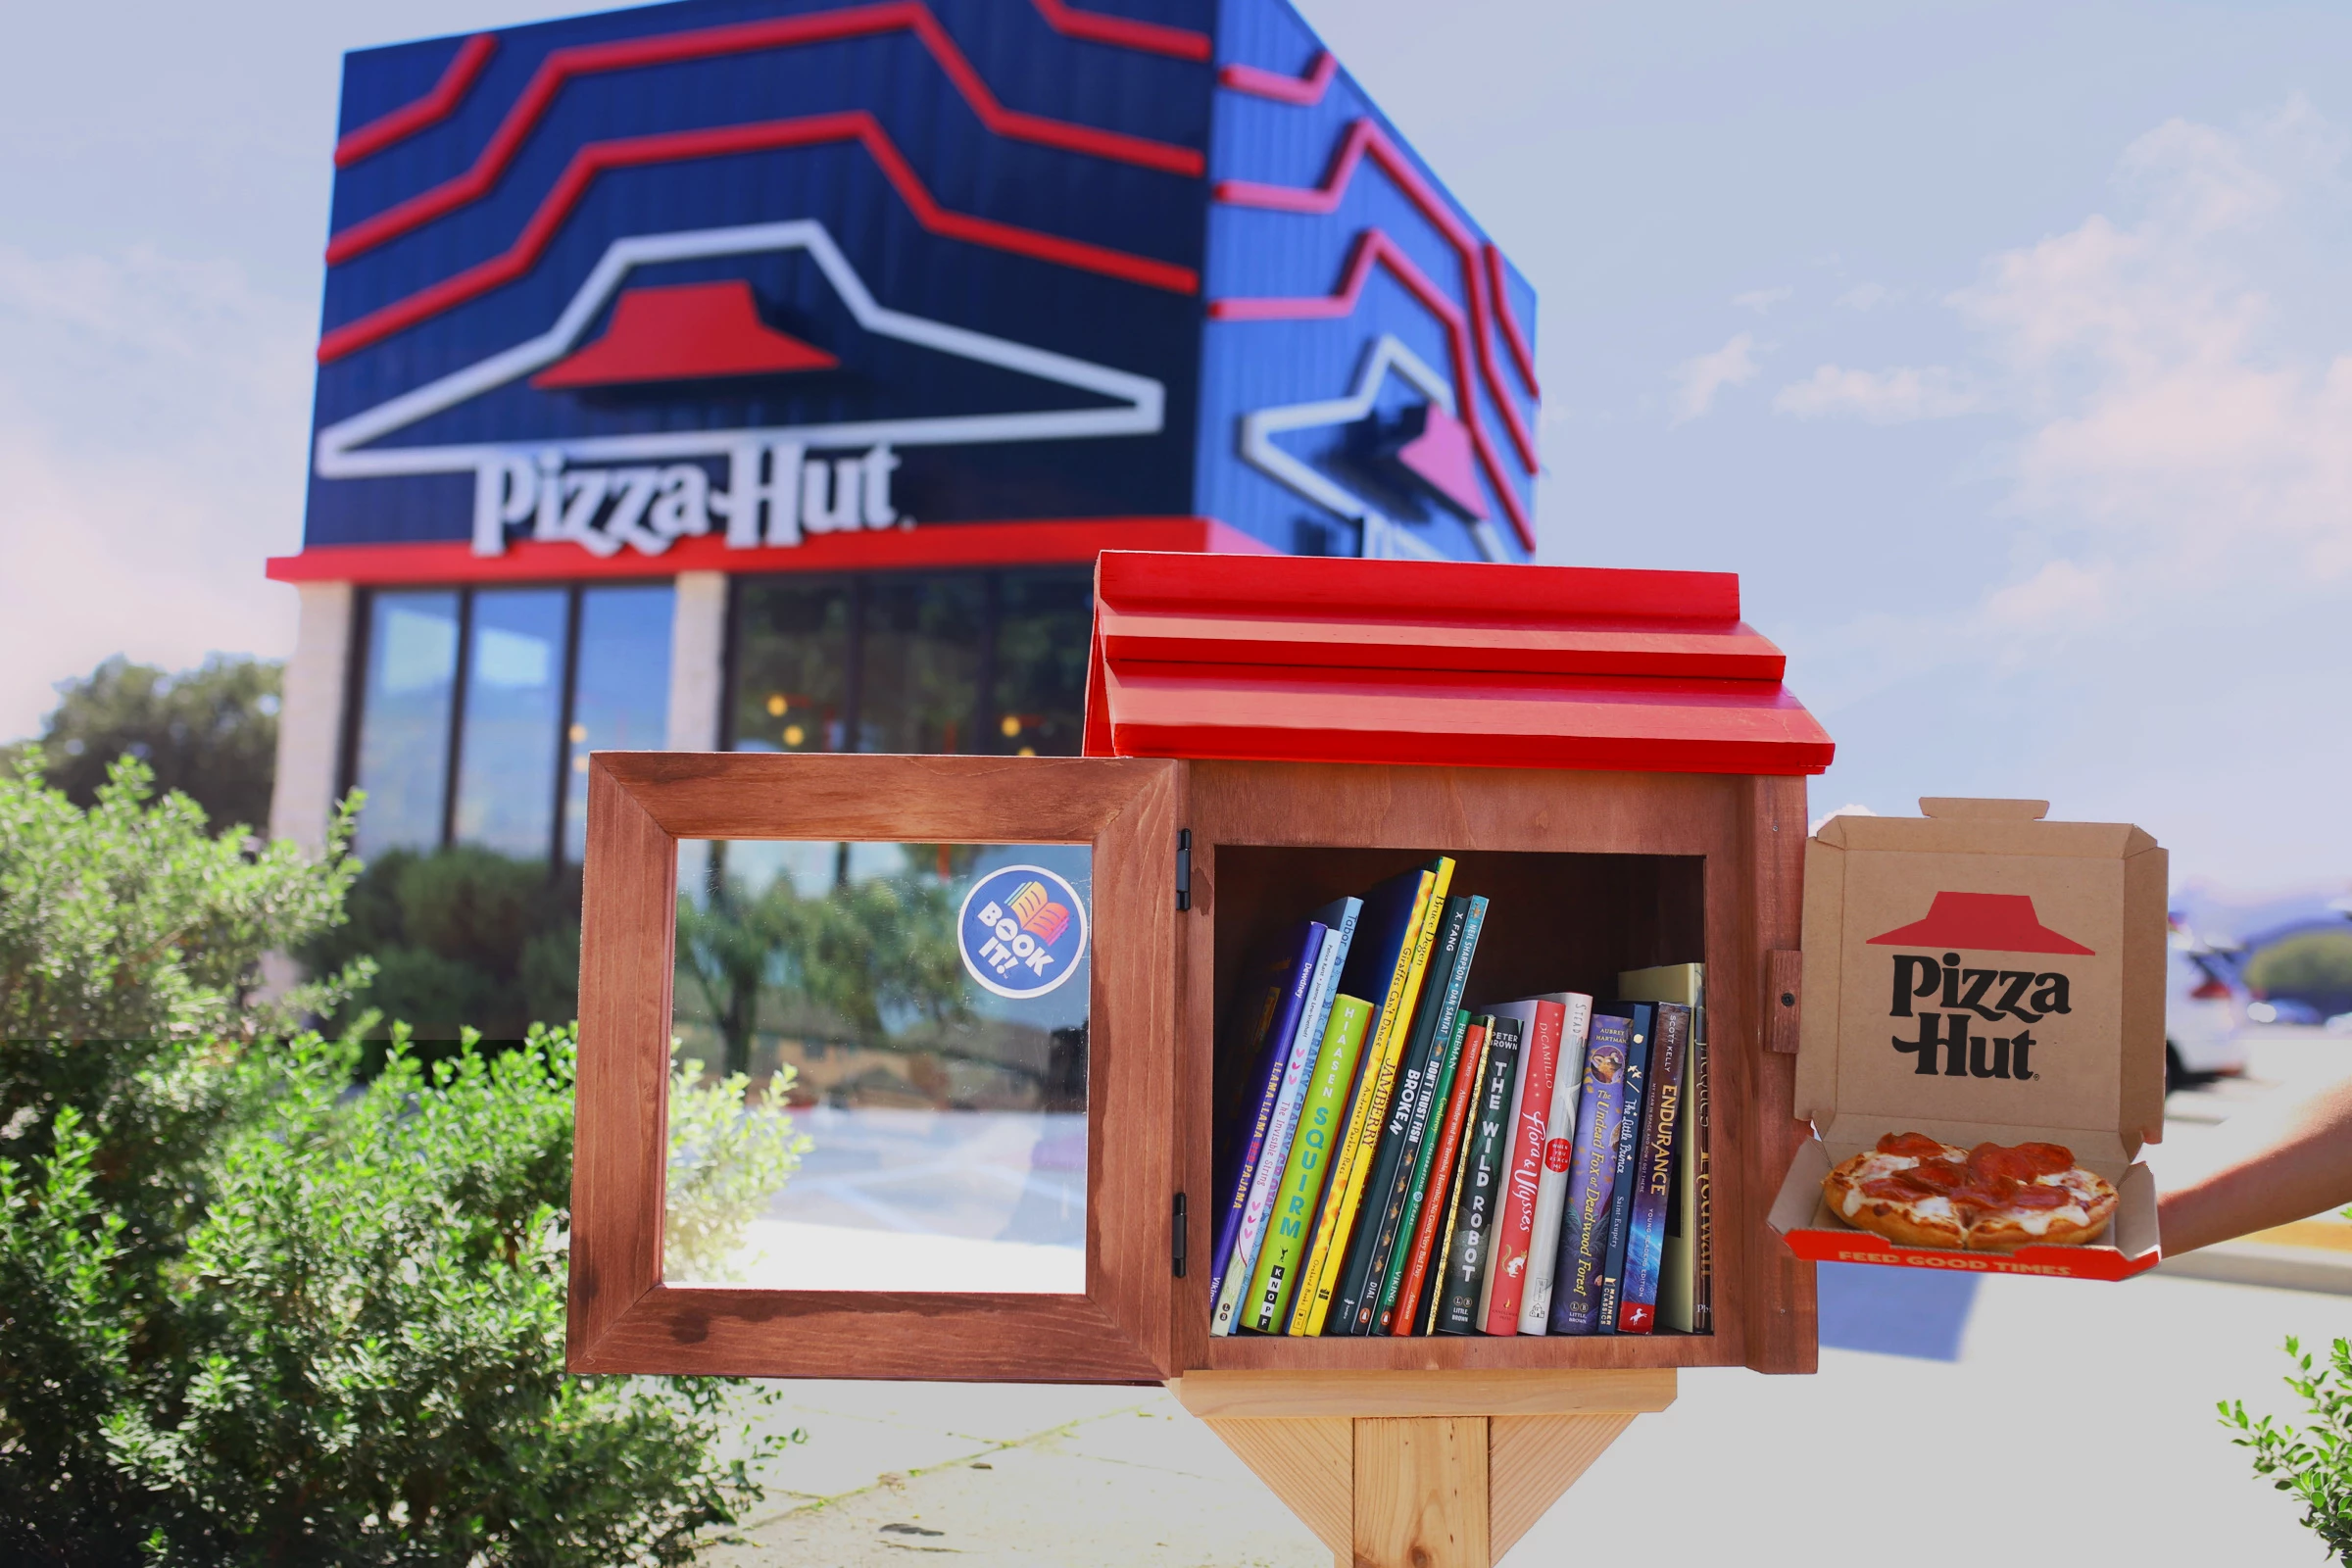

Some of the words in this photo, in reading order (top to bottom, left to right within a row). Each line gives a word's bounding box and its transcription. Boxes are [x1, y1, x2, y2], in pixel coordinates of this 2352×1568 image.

[471, 447, 710, 557] Pizza
[708, 441, 900, 549] Hut
[1428, 895, 1446, 927] Bruce
[1454, 911, 1464, 921] X.
[977, 901, 1054, 977] BOOK
[1340, 914, 1358, 947] Tabor
[1446, 924, 1460, 952] FANG
[1468, 923, 1478, 940] NEIL
[978, 936, 1019, 975] IT!
[1416, 931, 1435, 966] Degen
[1454, 940, 1473, 982] SHARPSON
[1295, 962, 1312, 999] Dewdney
[1394, 947, 1412, 986] Giraffes
[1386, 991, 1399, 1014] Can't
[1450, 989, 1459, 1004] DAN
[1888, 953, 2072, 1023] Pizza
[1375, 1018, 1392, 1047] Dance
[1441, 1005, 1454, 1035] SANTAT
[1572, 1003, 1587, 1034] STEAD
[1668, 1015, 1677, 1044] SCOTT
[1322, 1006, 1354, 1099] HIAASEN
[1448, 1023, 1466, 1070] FREEMAN
[1595, 1035, 1627, 1044] HARTMAN
[1891, 1012, 2036, 1081] Hut
[1424, 1061, 1440, 1089] DON'T
[1664, 1046, 1673, 1073] KELLY
[1266, 1061, 1283, 1099] LLAMA
[1489, 1061, 1507, 1110] THE
[1597, 1089, 1612, 1100] The
[1651, 1082, 1657, 1091] MY
[1278, 1102, 1290, 1116] The
[1361, 1057, 1396, 1149] JAMBERRY
[1389, 1069, 1421, 1136] BROKEN
[1417, 1091, 1435, 1117] TRUST
[1431, 1098, 1447, 1134] Corduroy
[1454, 1089, 1466, 1122] Alexander
[1624, 1099, 1638, 1116] The
[1253, 1101, 1272, 1138] LLAMA
[1409, 1119, 1423, 1144] FISH
[1522, 1110, 1545, 1158] Flora
[1592, 1101, 1610, 1150] Undead
[1621, 1114, 1634, 1141] Little
[1247, 1141, 1260, 1162] RED
[1267, 1119, 1285, 1156] Invisible
[1340, 1128, 1359, 1174] Parker-Rees
[1650, 1085, 1678, 1196] ENDURANCE
[1441, 1147, 1452, 1173] Terrible,
[1476, 1121, 1499, 1187] WILD
[1524, 1158, 1536, 1168] &
[1590, 1151, 1604, 1174] Fox
[1617, 1143, 1632, 1174] Prince
[1233, 1164, 1253, 1209] PAJAMA
[1256, 1159, 1273, 1187] String
[1279, 1106, 1329, 1239] SQUIRM
[1433, 1174, 1446, 1202] Horrible,
[1431, 1203, 1439, 1214] No
[1512, 1168, 1538, 1233] Ulysses
[1425, 1214, 1436, 1234] Good,
[1580, 1188, 1600, 1257] Deadwood
[1645, 1208, 1654, 1234] YOUNG
[1419, 1235, 1431, 1250] Very
[1462, 1195, 1486, 1283] ROBOT
[1642, 1236, 1652, 1266] READERS
[1307, 1259, 1319, 1286] Orchard
[1412, 1264, 1424, 1279] Day
[1417, 1250, 1427, 1264] Bad
[1838, 1250, 1900, 1264] FEED
[1907, 1255, 1986, 1270] GOOD
[1991, 1261, 2072, 1277] TIMES
[1366, 1282, 1378, 1299] DIAL
[1388, 1271, 1401, 1302] VIKING
[1574, 1259, 1592, 1297] Forest
[1259, 1266, 1283, 1327] KNOPF
[1301, 1288, 1311, 1305] Books
[1600, 1288, 1610, 1325] CLASSICS
[1605, 1289, 1615, 1326] MARINER
